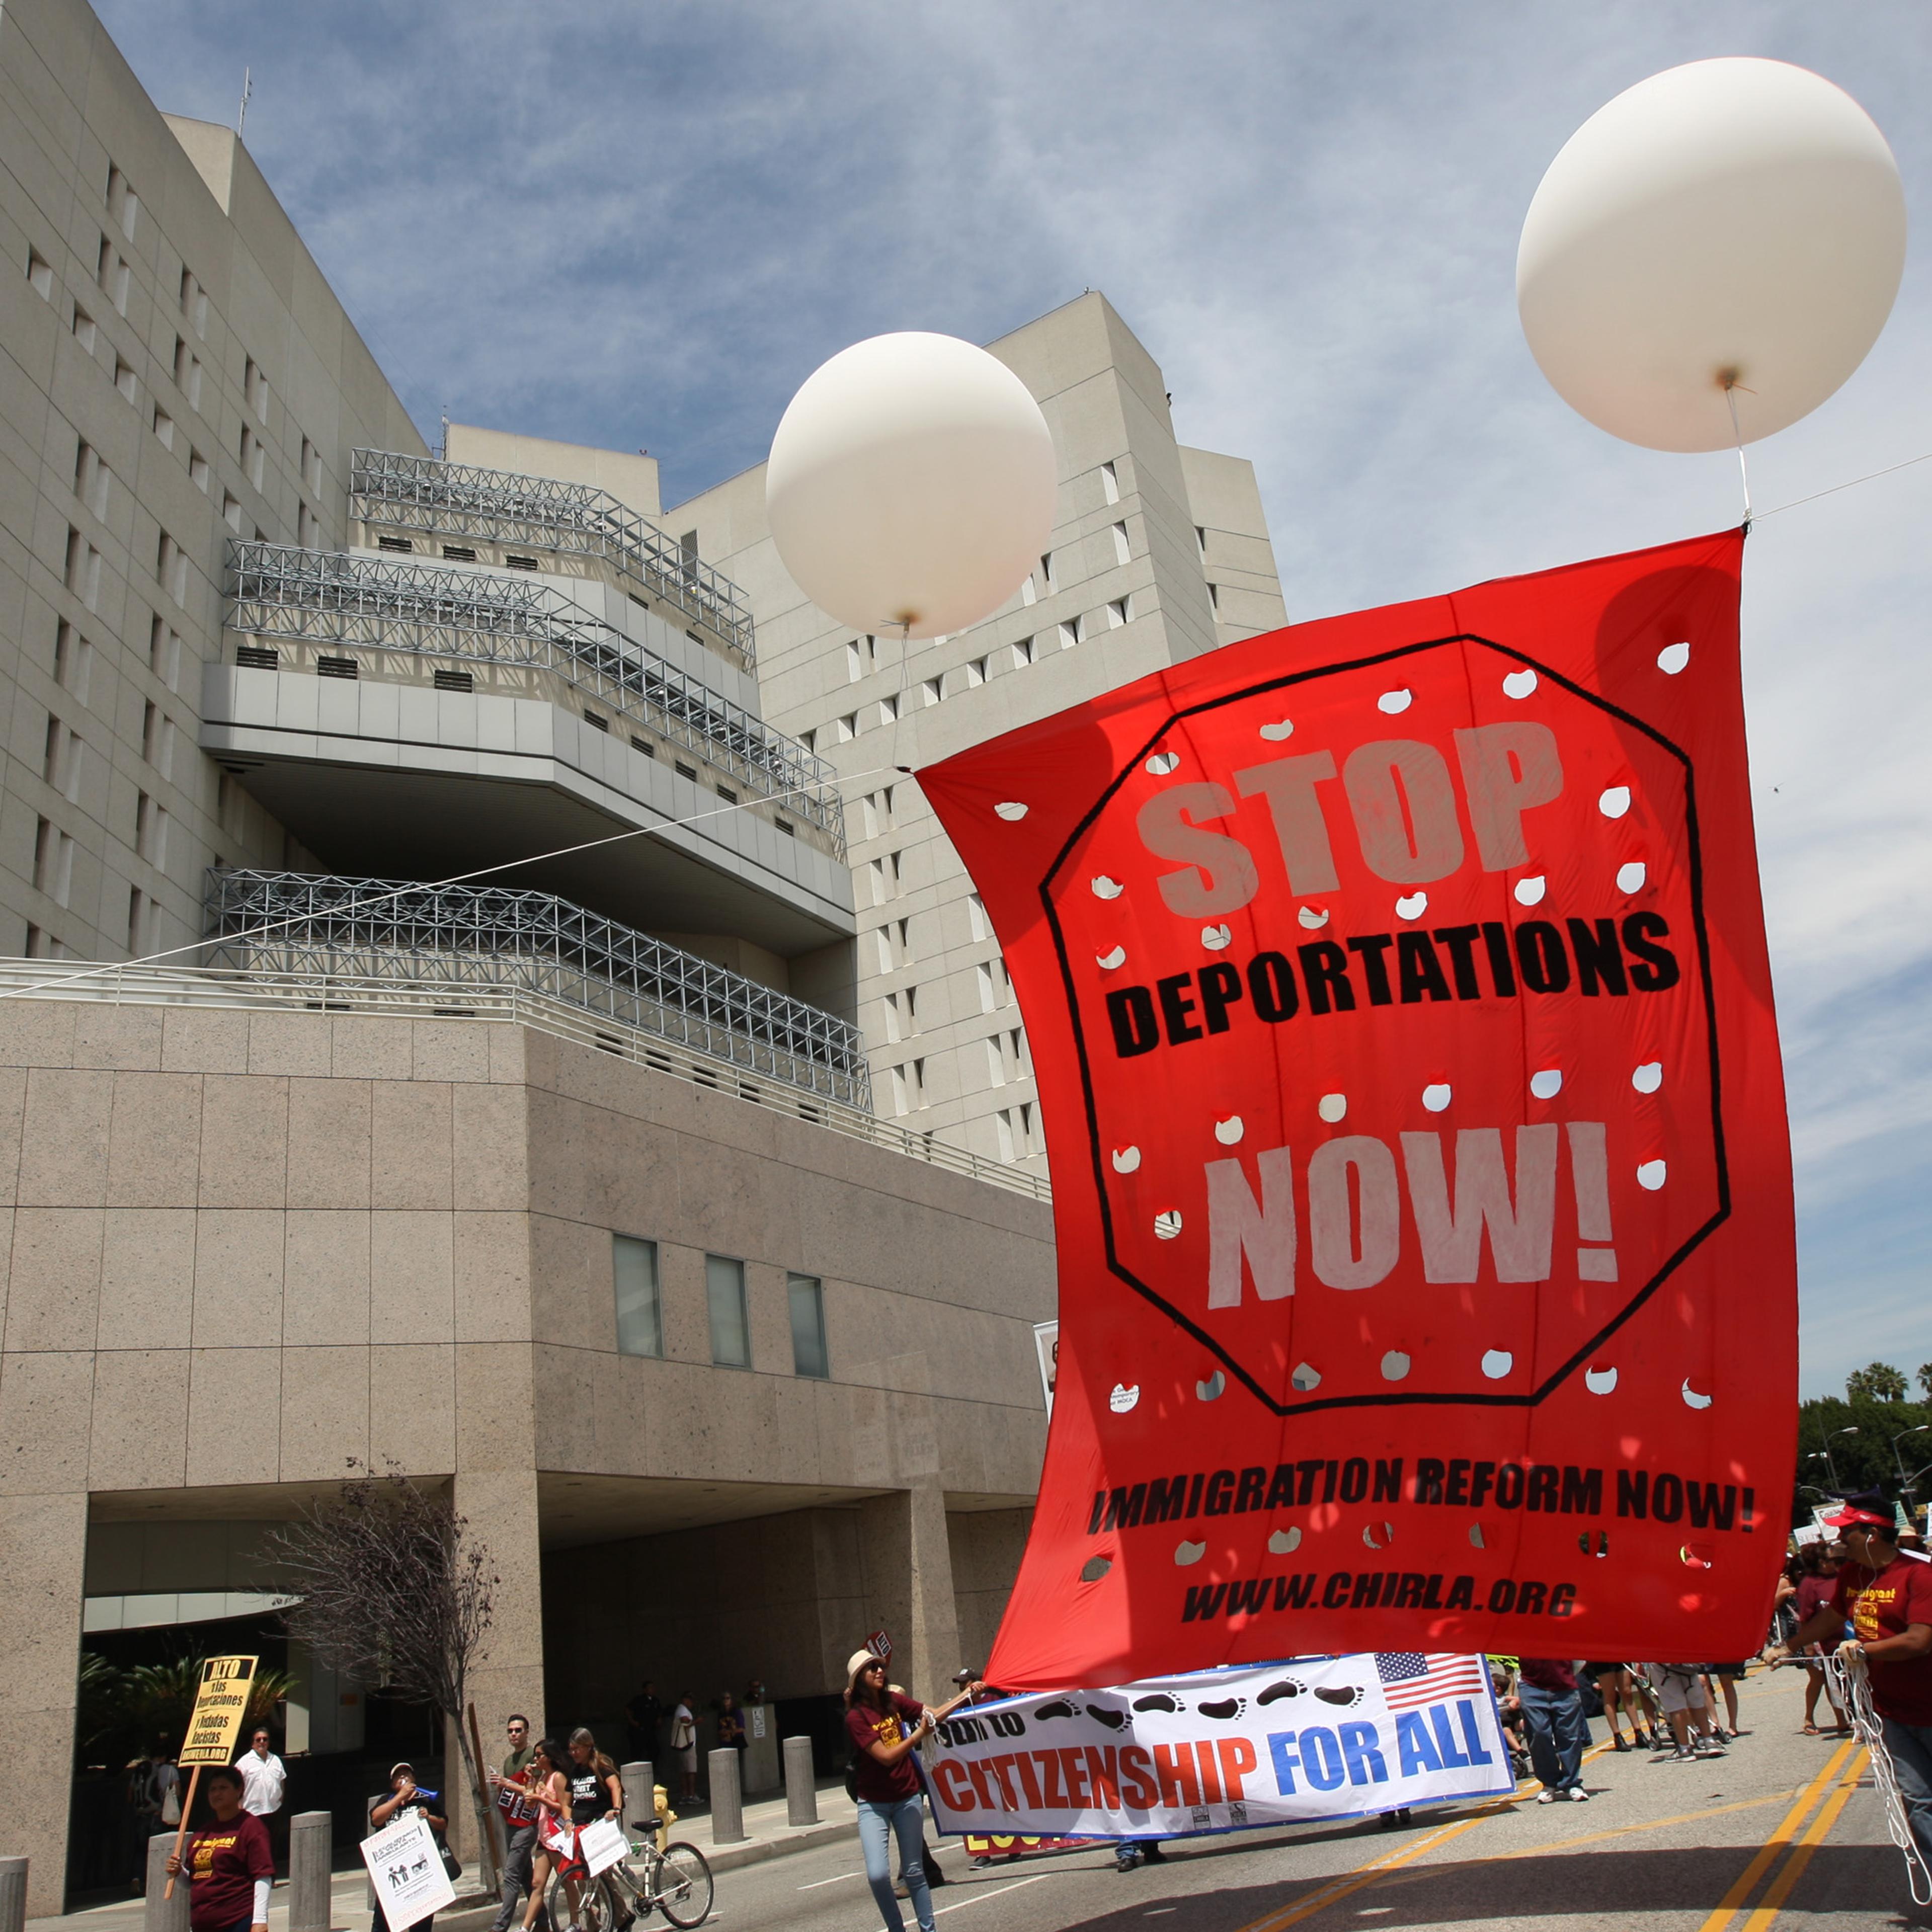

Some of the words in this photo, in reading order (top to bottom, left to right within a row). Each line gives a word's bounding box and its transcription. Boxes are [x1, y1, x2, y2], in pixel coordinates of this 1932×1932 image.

[1136, 721, 1564, 919] STOP
[1106, 911, 1680, 1059] DEPORTATIONS
[1203, 1121, 1619, 1310] NOW!
[1086, 1457, 1403, 1535] IMMIGRATION
[1414, 1458, 1603, 1515] REFORM
[1617, 1469, 1755, 1533] NOW!
[1181, 1571, 1577, 1623] WWW.CHIRLA.ORG
[209, 1660, 241, 1680] ALTO
[877, 1634, 890, 1654] ALTO
[911, 1718, 989, 1751] ath
[985, 1712, 1026, 1738] to
[931, 1737, 1258, 1812] CITIZENSHIP
[1266, 1720, 1389, 1797] FOR
[1395, 1699, 1493, 1778] ALL
